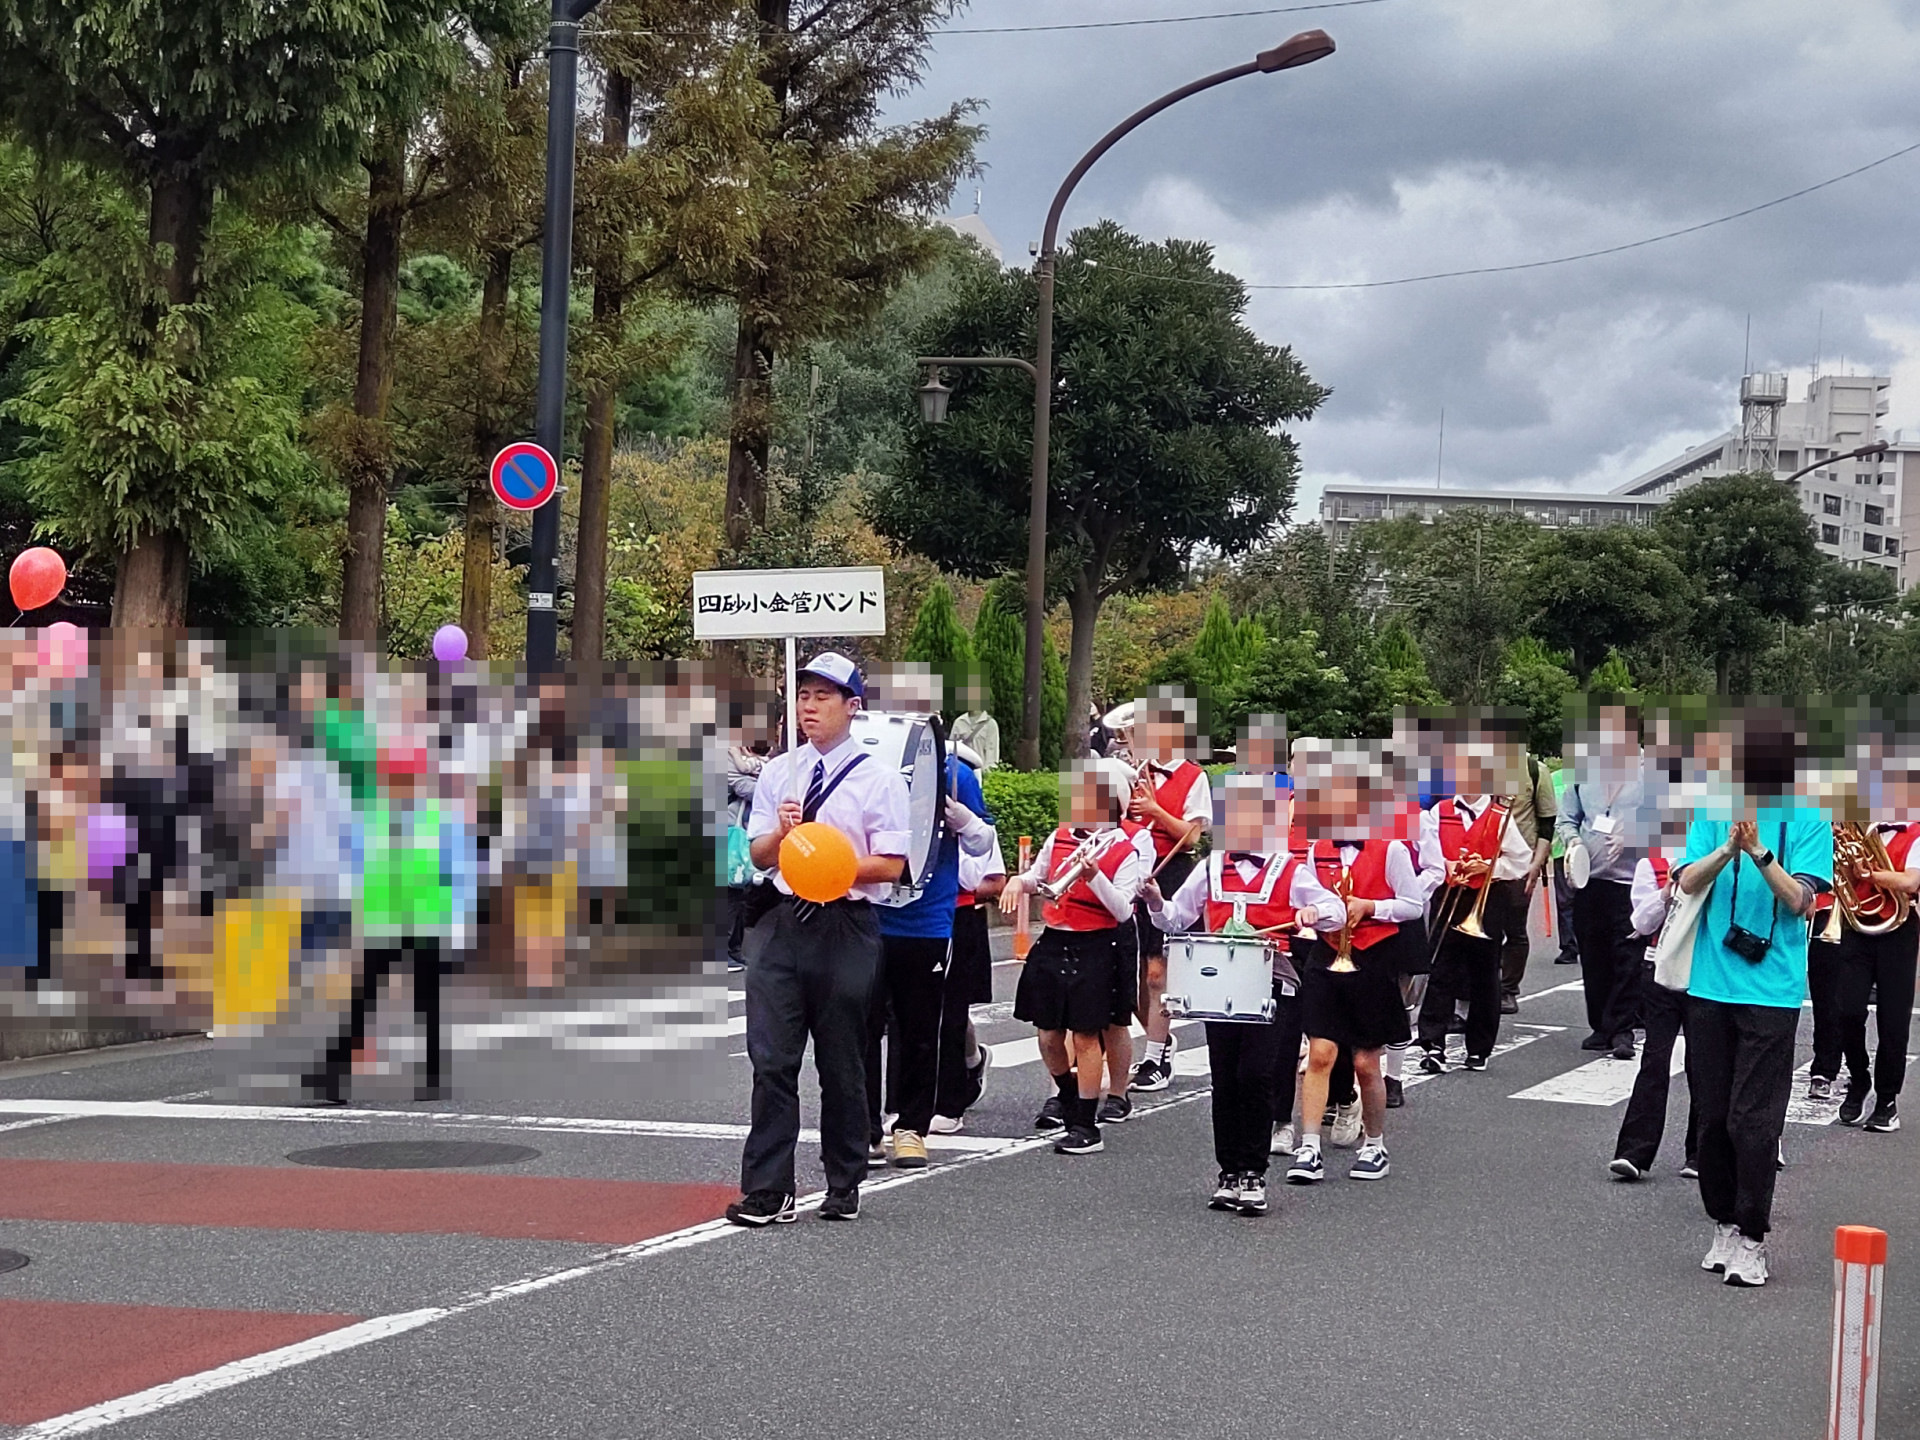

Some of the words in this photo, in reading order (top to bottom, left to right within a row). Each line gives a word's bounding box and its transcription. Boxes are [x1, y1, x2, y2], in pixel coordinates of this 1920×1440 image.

[698, 591, 877, 615] 四砂小金管バンド
